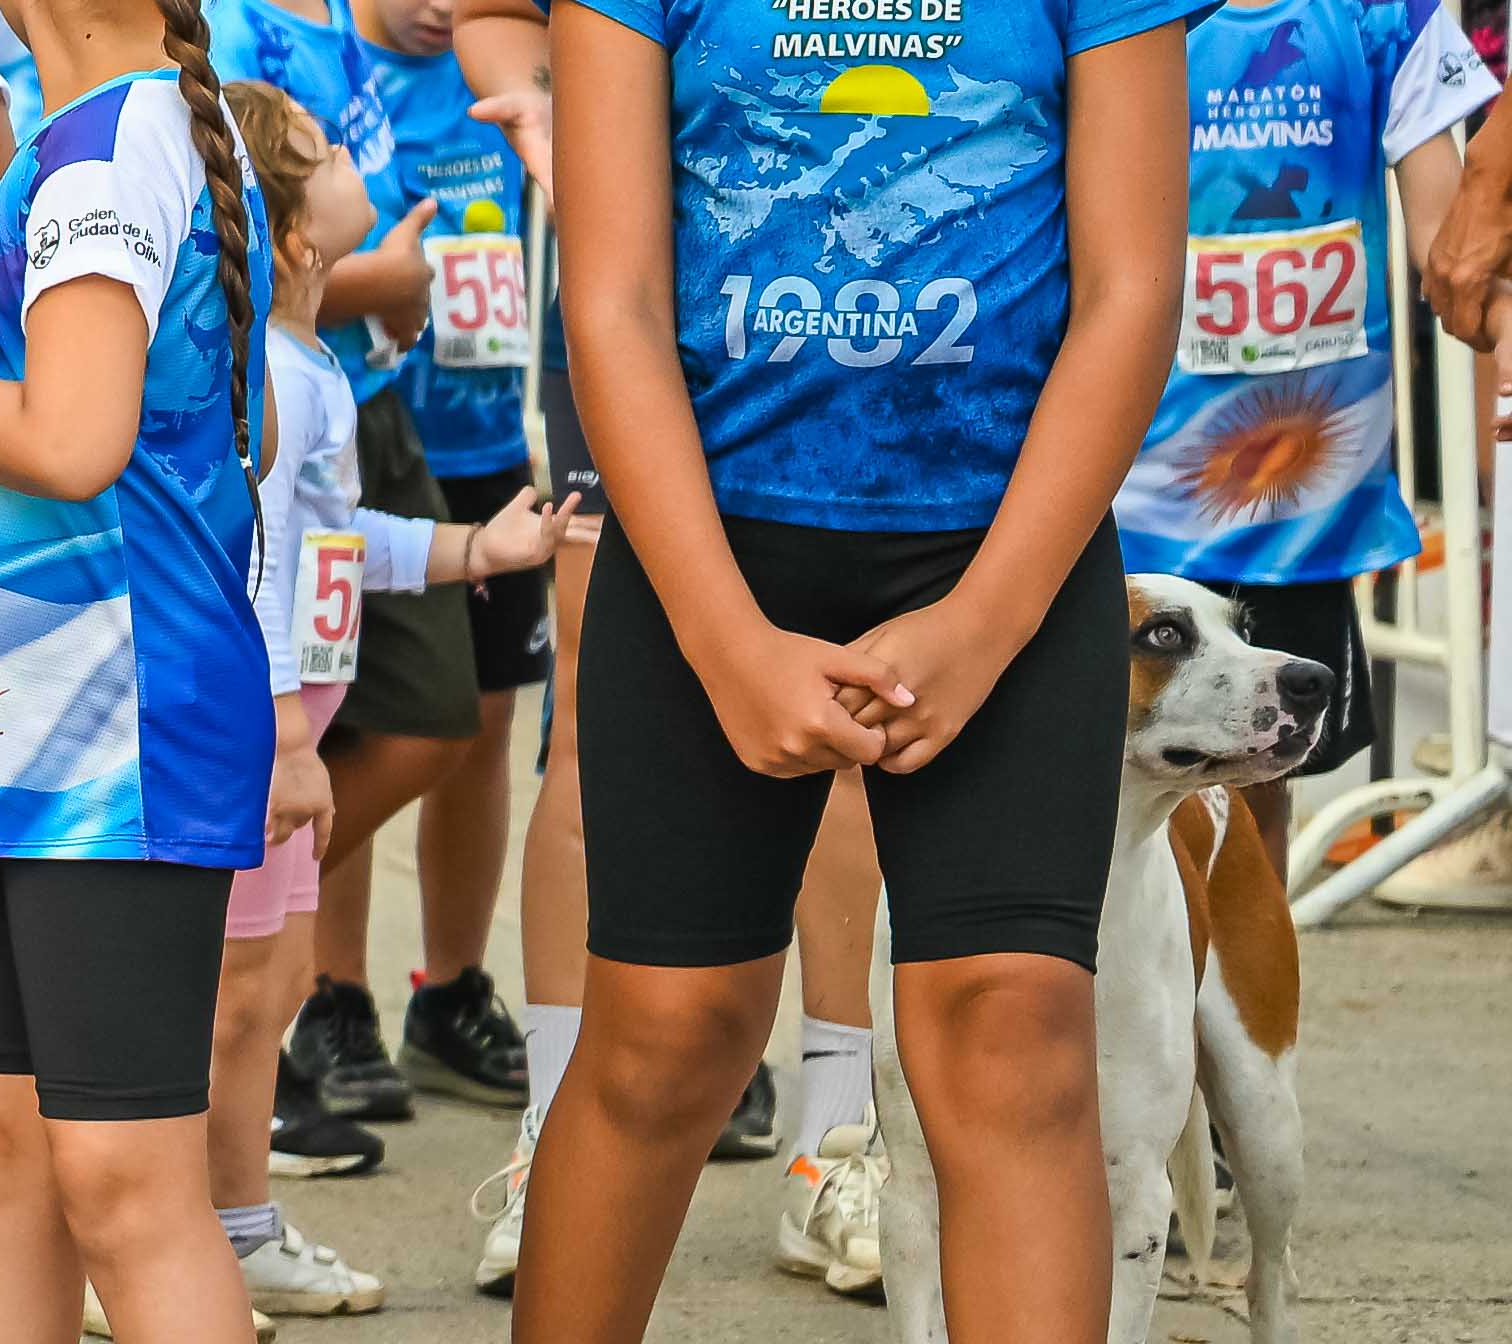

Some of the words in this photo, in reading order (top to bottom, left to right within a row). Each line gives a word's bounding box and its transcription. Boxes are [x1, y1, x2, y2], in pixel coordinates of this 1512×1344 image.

[1193, 119, 1334, 151] MALVINAS
[719, 275, 978, 367] 1982
[753, 308, 919, 336] ARGENTINA
[1195, 240, 1356, 337] 562
[313, 547, 362, 642] 5
